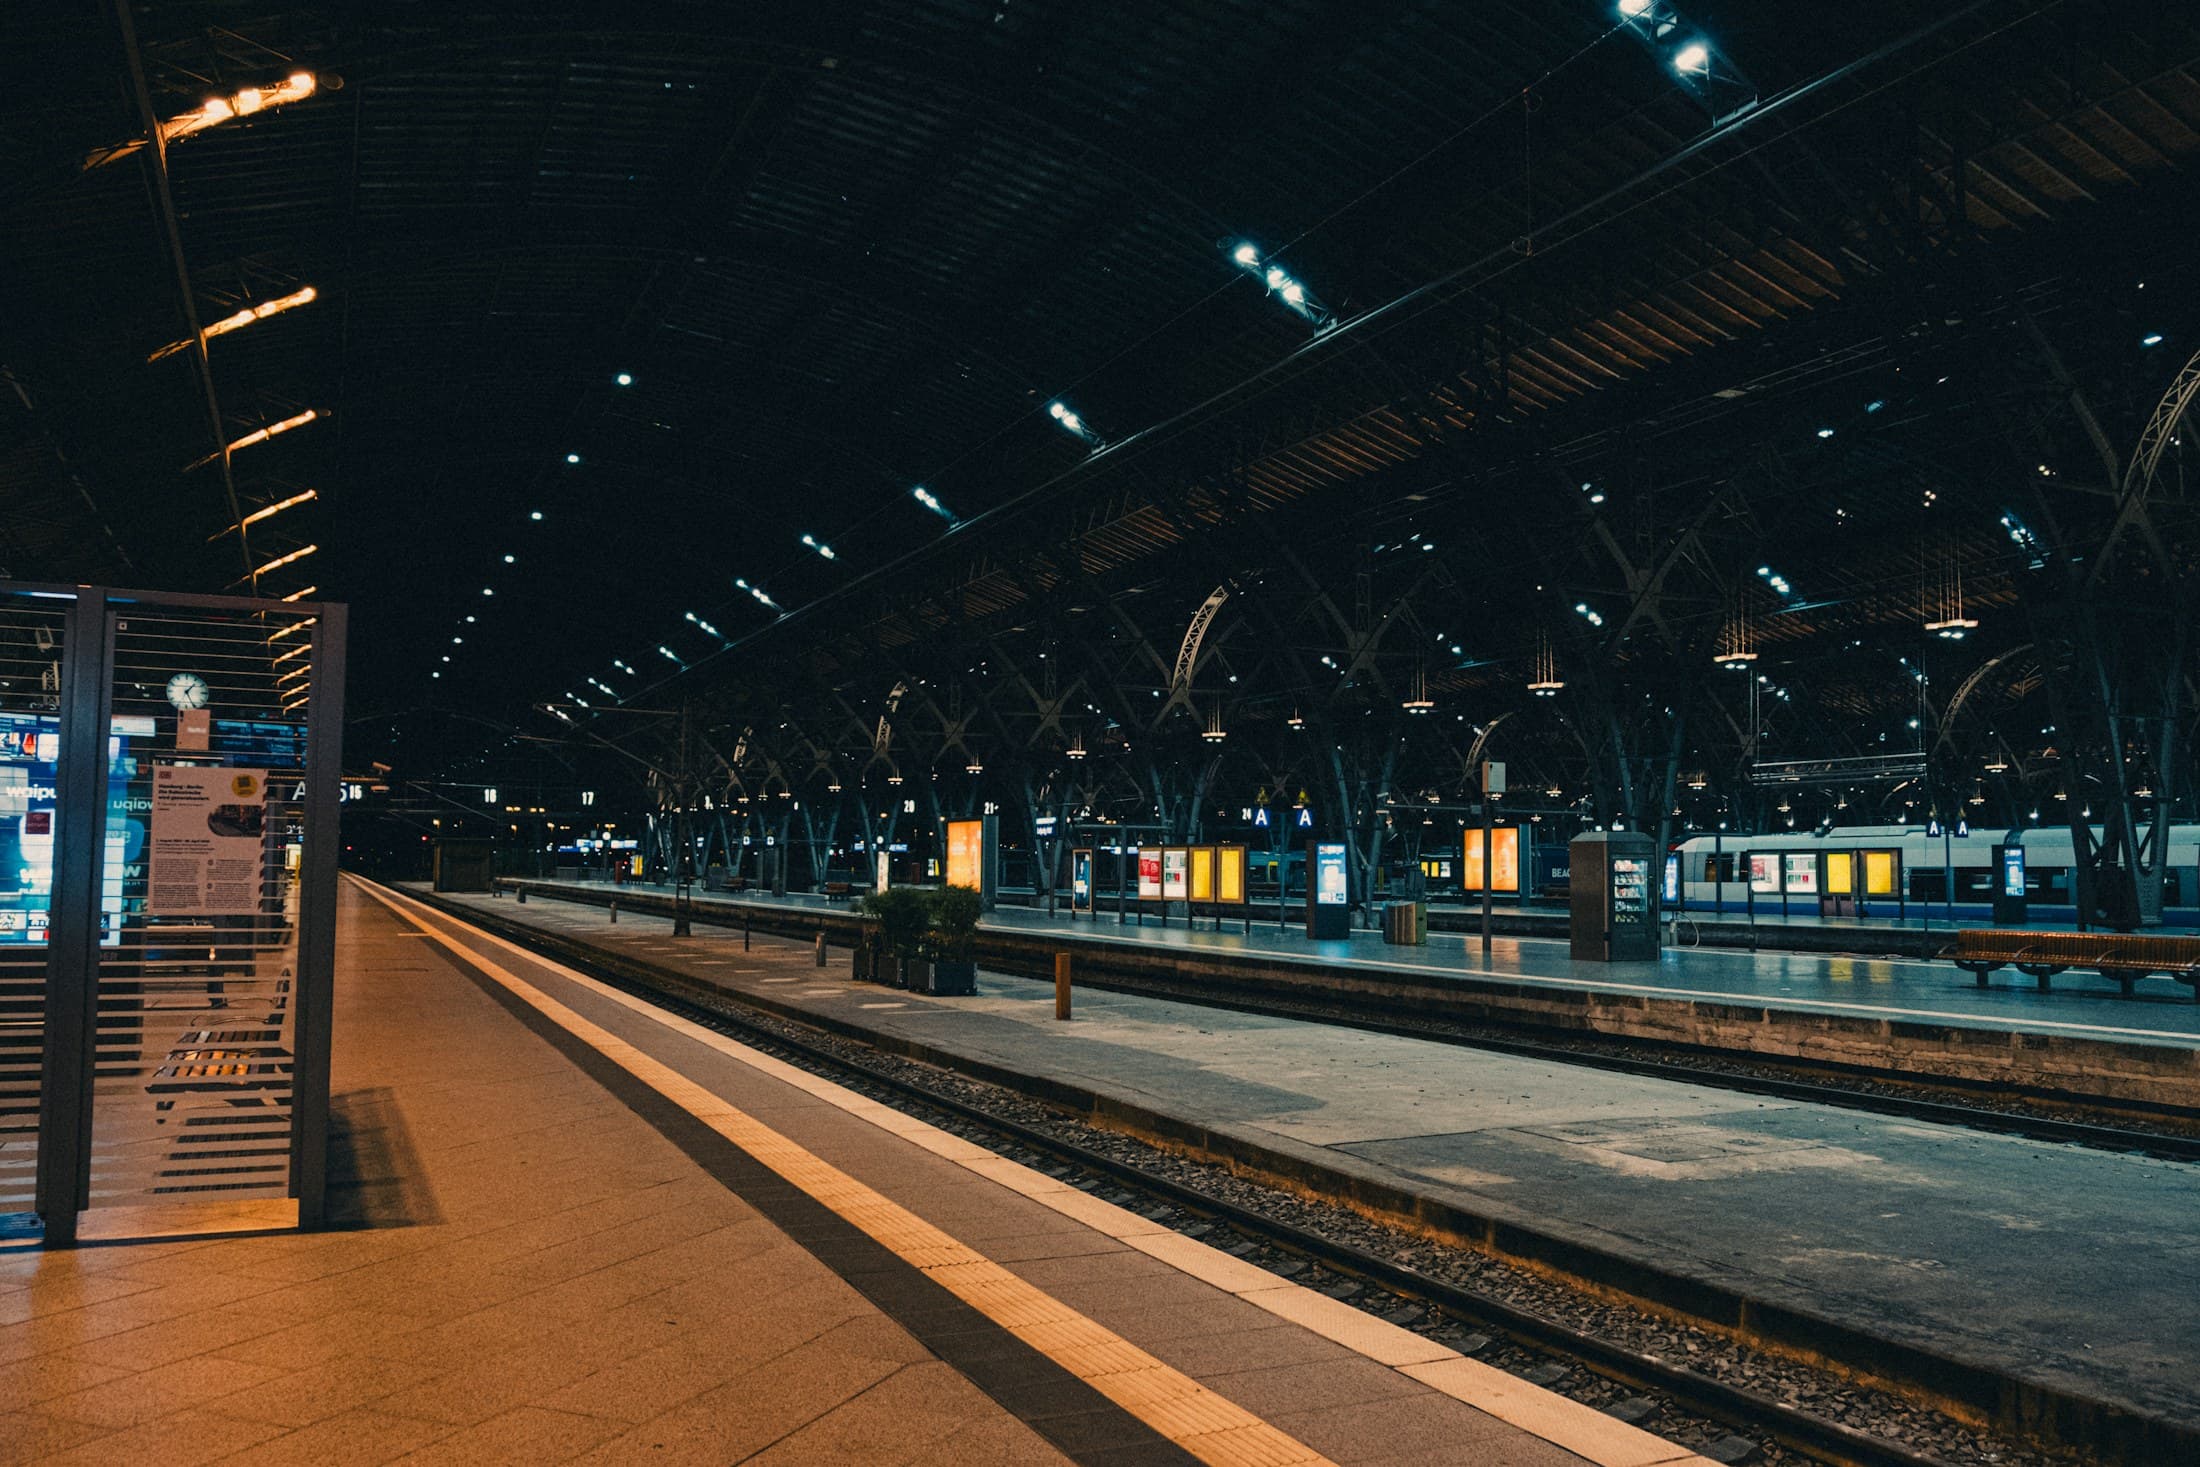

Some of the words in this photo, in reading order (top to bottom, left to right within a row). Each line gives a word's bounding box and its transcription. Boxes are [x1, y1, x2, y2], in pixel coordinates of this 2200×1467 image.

[349, 785, 362, 800] 15
[582, 791, 594, 806] 17
[903, 800, 915, 813] 20
[984, 802, 995, 815] 21
[1255, 807, 1268, 826] A
[1299, 808, 1312, 827] A
[1929, 820, 1939, 835] A
[1958, 820, 1968, 835] A
